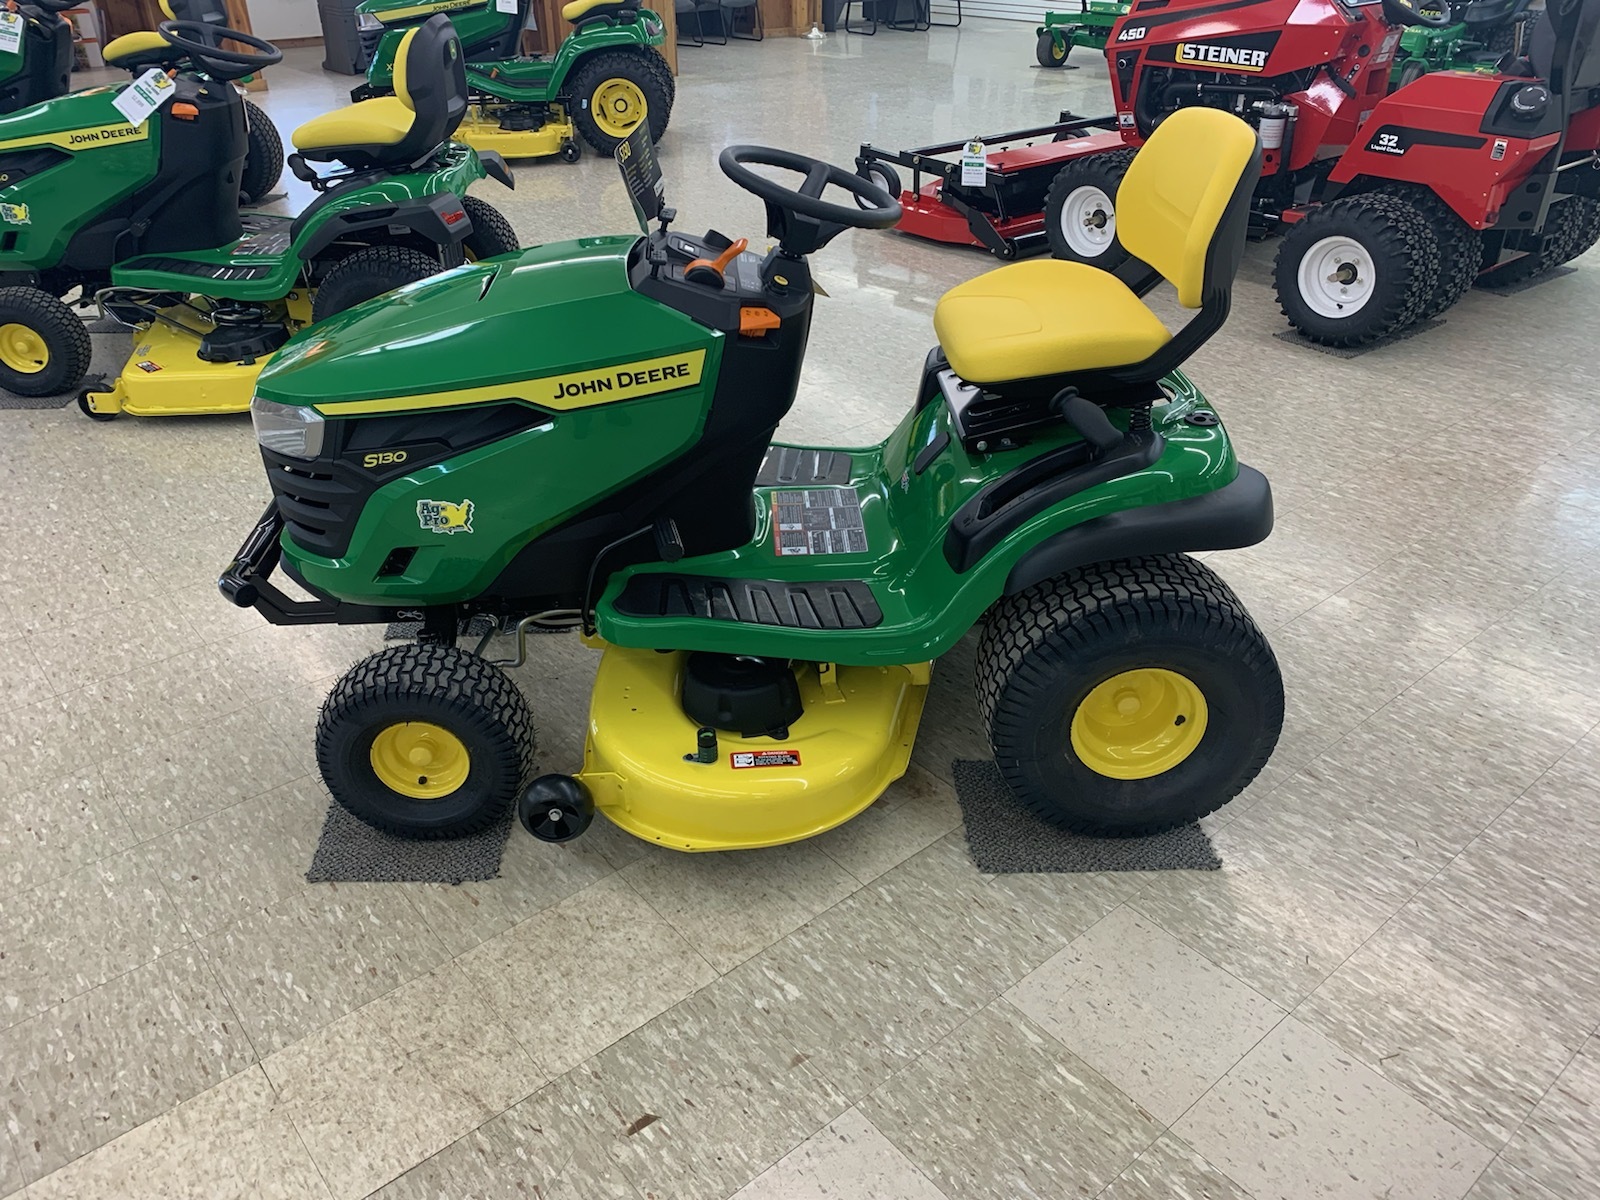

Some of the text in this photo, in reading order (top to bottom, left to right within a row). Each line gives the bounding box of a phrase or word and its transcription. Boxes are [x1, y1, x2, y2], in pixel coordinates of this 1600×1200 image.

[1118, 27, 1146, 40] 450
[1182, 43, 1266, 66] STEINER
[69, 127, 142, 144] JOHN DEERE
[1379, 133, 1399, 147] 32
[554, 363, 690, 399] JOHN DEERE
[363, 450, 408, 468] S130
[421, 503, 446, 516] Ag-
[423, 514, 449, 526] Pro
